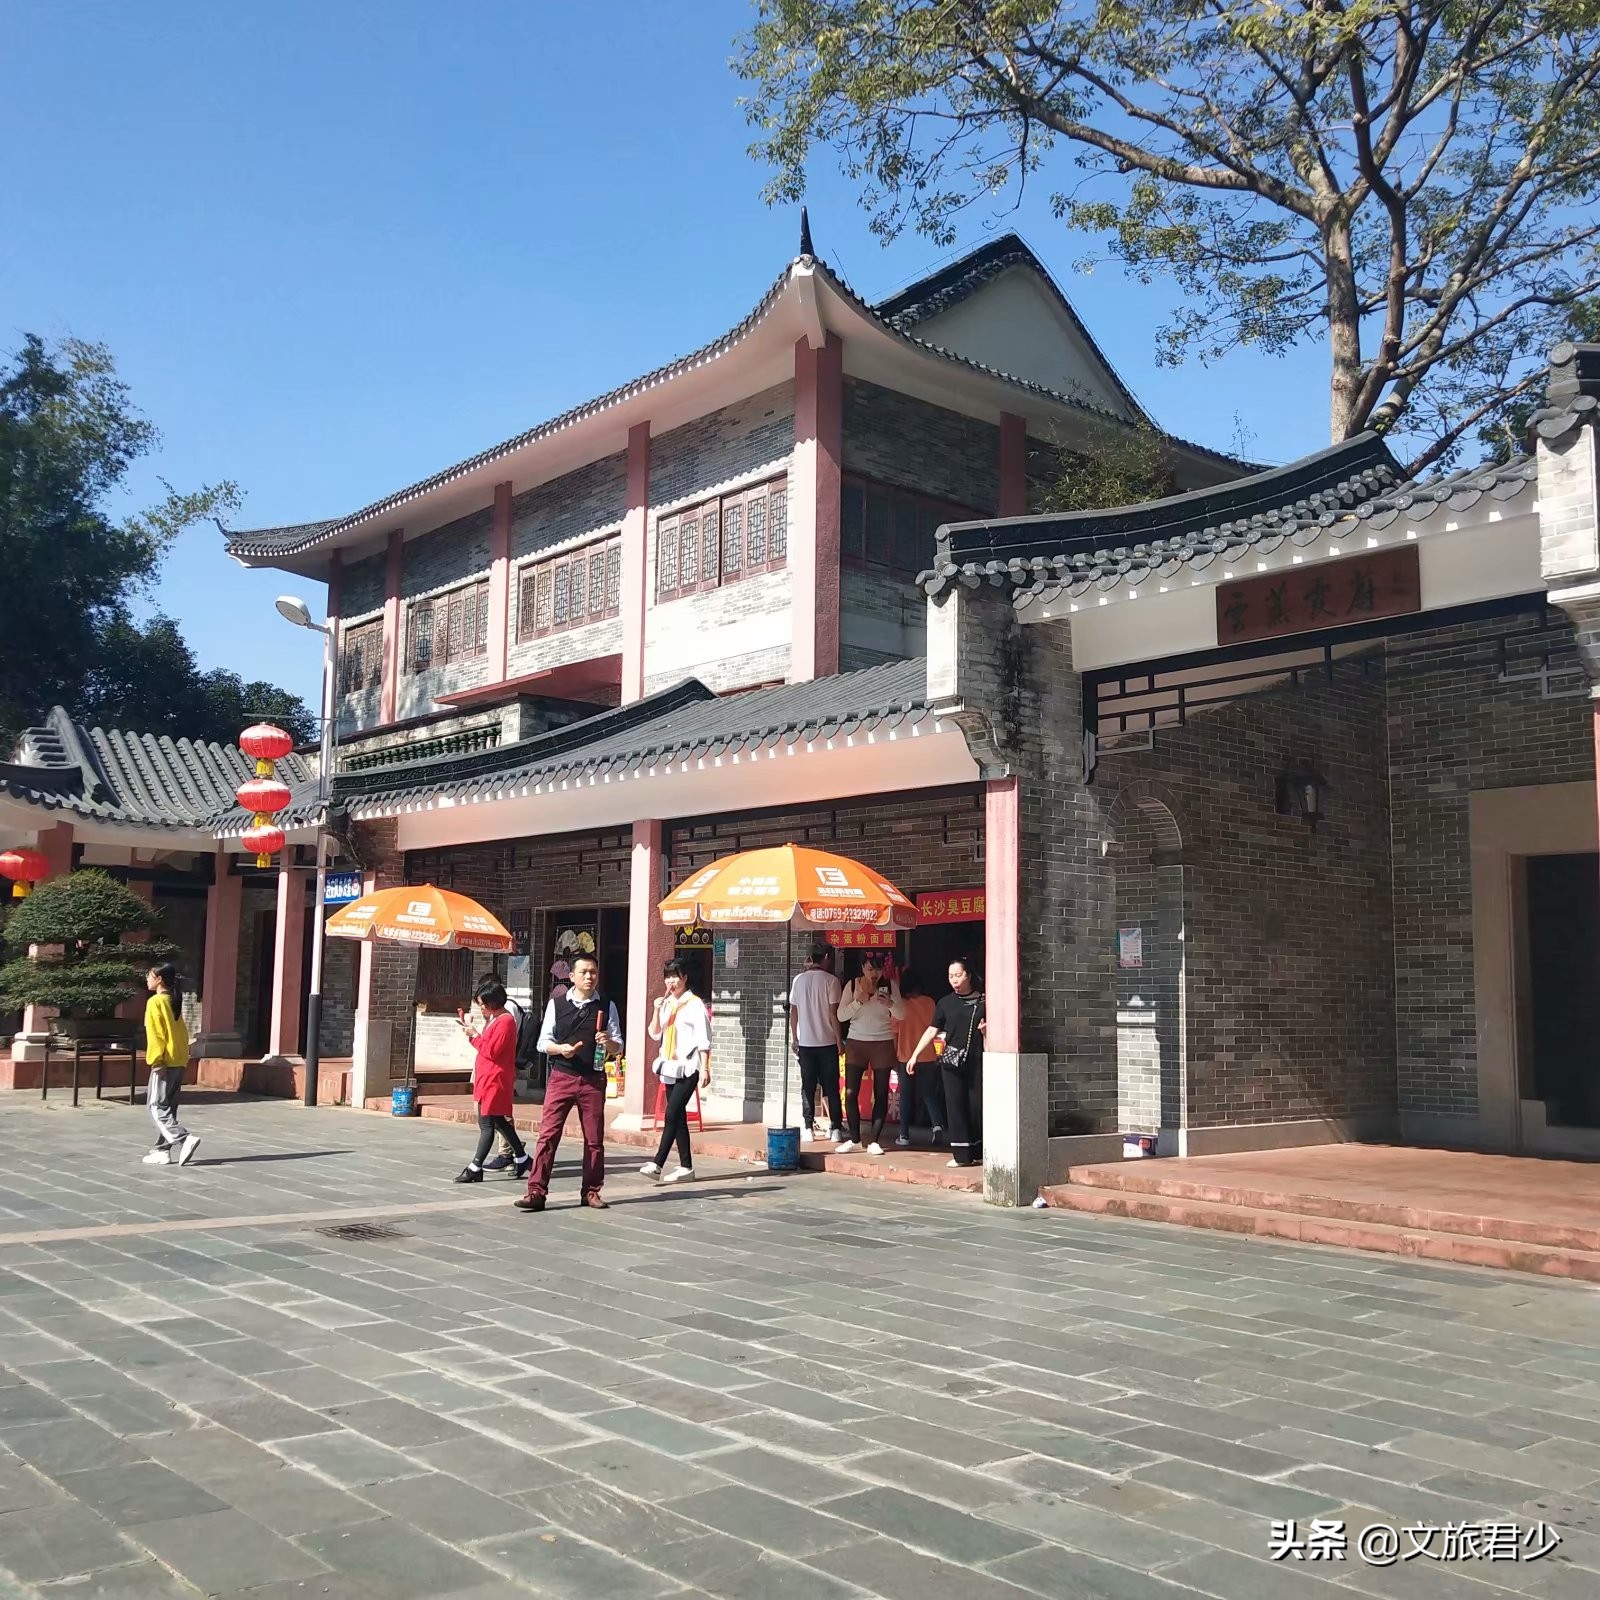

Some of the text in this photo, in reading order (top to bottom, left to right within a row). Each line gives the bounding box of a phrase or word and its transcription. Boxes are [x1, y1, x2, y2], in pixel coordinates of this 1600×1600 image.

[920, 896, 985, 917] 长沙臭豆腐
